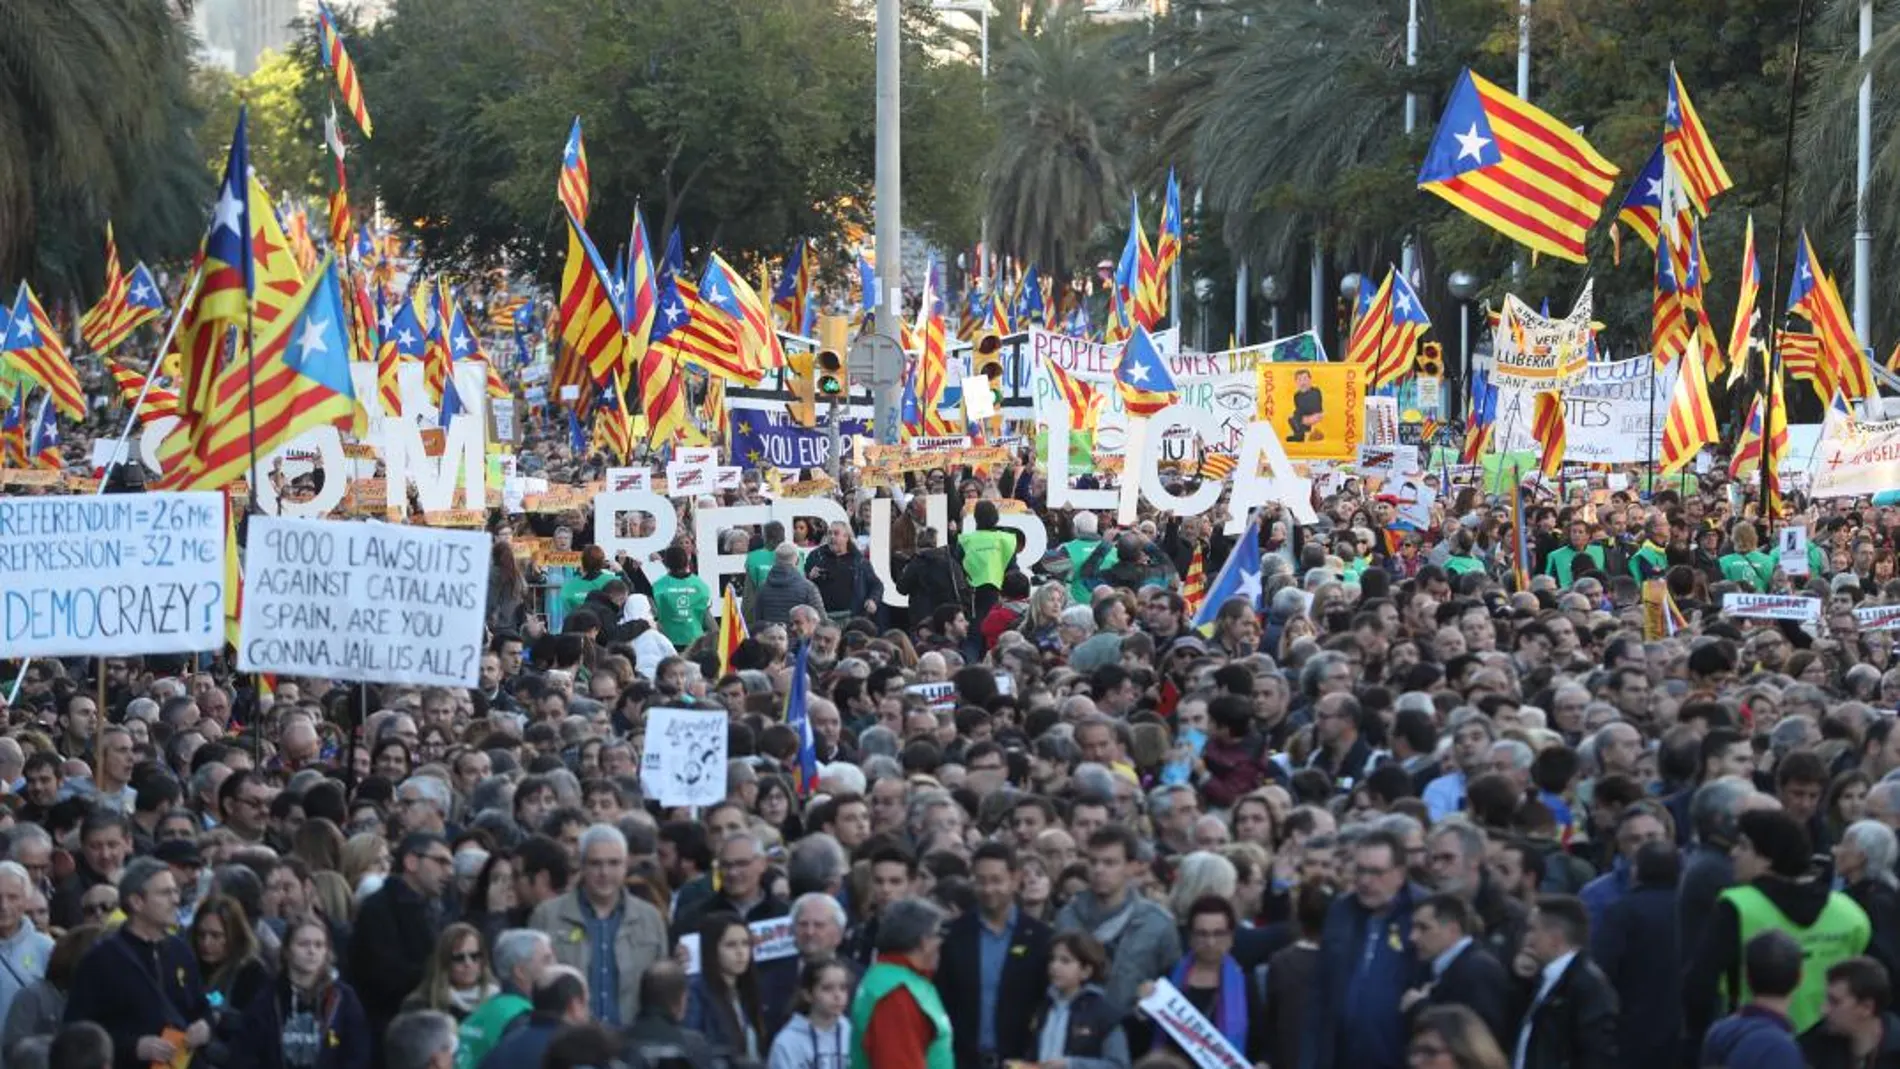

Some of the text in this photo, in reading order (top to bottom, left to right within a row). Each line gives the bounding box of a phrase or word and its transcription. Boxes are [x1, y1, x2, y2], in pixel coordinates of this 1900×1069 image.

[1035, 333, 1112, 373] PEOPLE
[1497, 350, 1557, 368] LLIBERTAT
[1344, 369, 1357, 456] DEMOCRACY
[758, 434, 793, 466] YOU
[0, 502, 131, 537] REFERENDUM
[349, 534, 472, 575] LAWSUITS
[255, 567, 477, 610] AGAINST CATALANS
[1736, 596, 1809, 609] LLIBERTAT
[346, 608, 393, 636] ARE
[402, 608, 443, 638] YOU
[247, 637, 331, 667] GONNA
[388, 644, 414, 672] US
